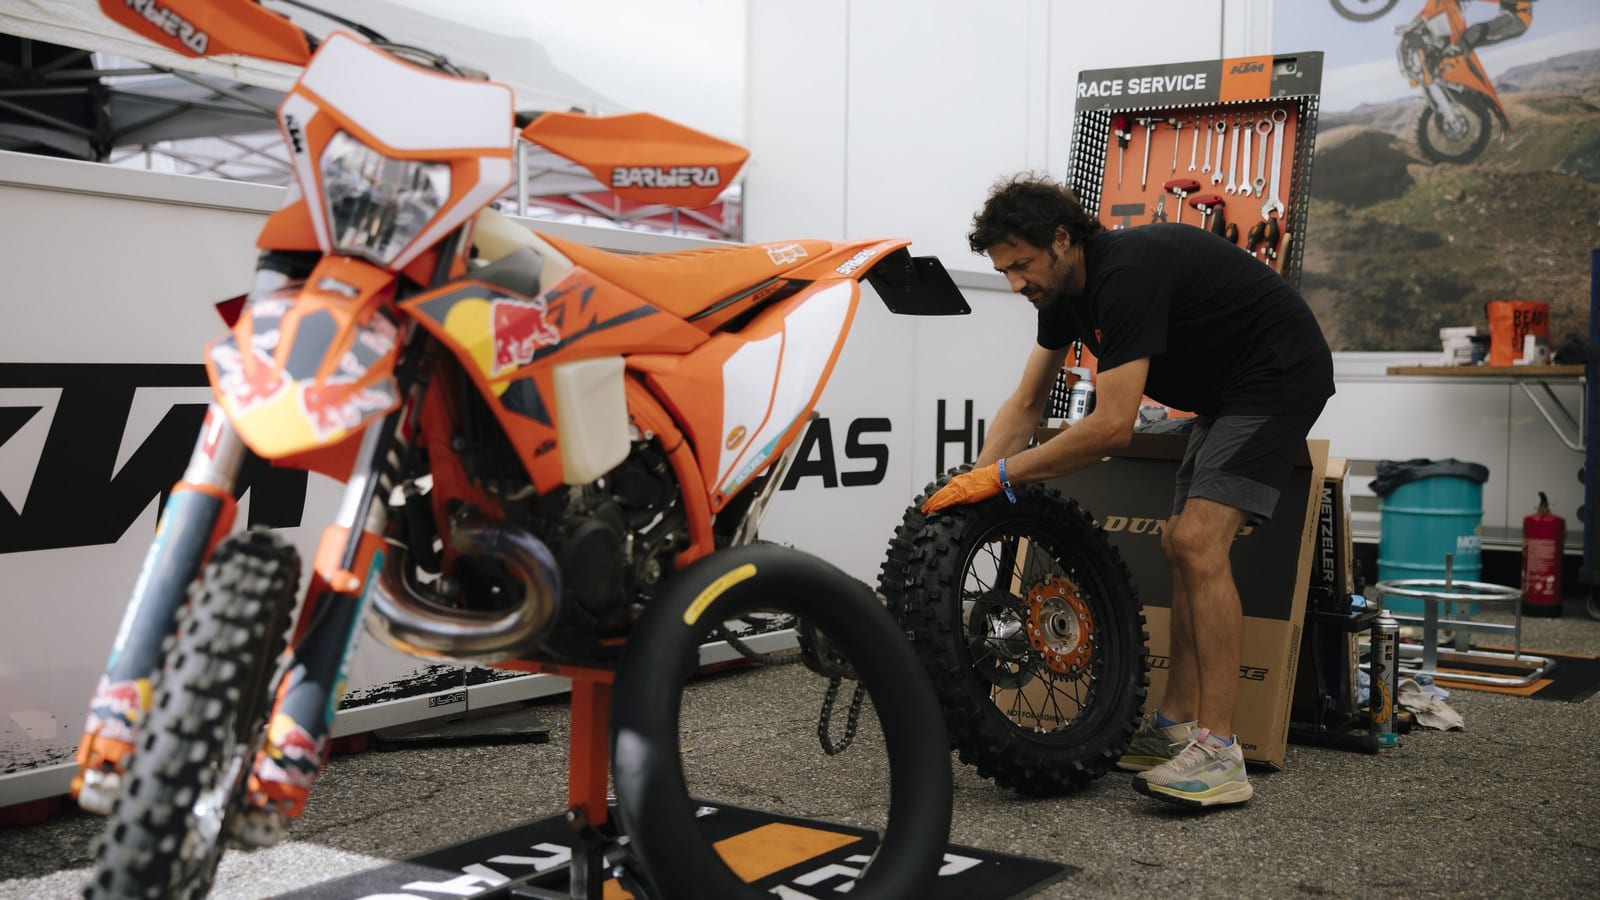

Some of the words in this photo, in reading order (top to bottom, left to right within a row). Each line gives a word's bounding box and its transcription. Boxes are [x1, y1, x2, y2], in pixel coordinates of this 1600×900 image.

[1077, 79, 1123, 98] RACE
[1127, 73, 1207, 95] SERVICE
[1321, 487, 1335, 582] METZELER
